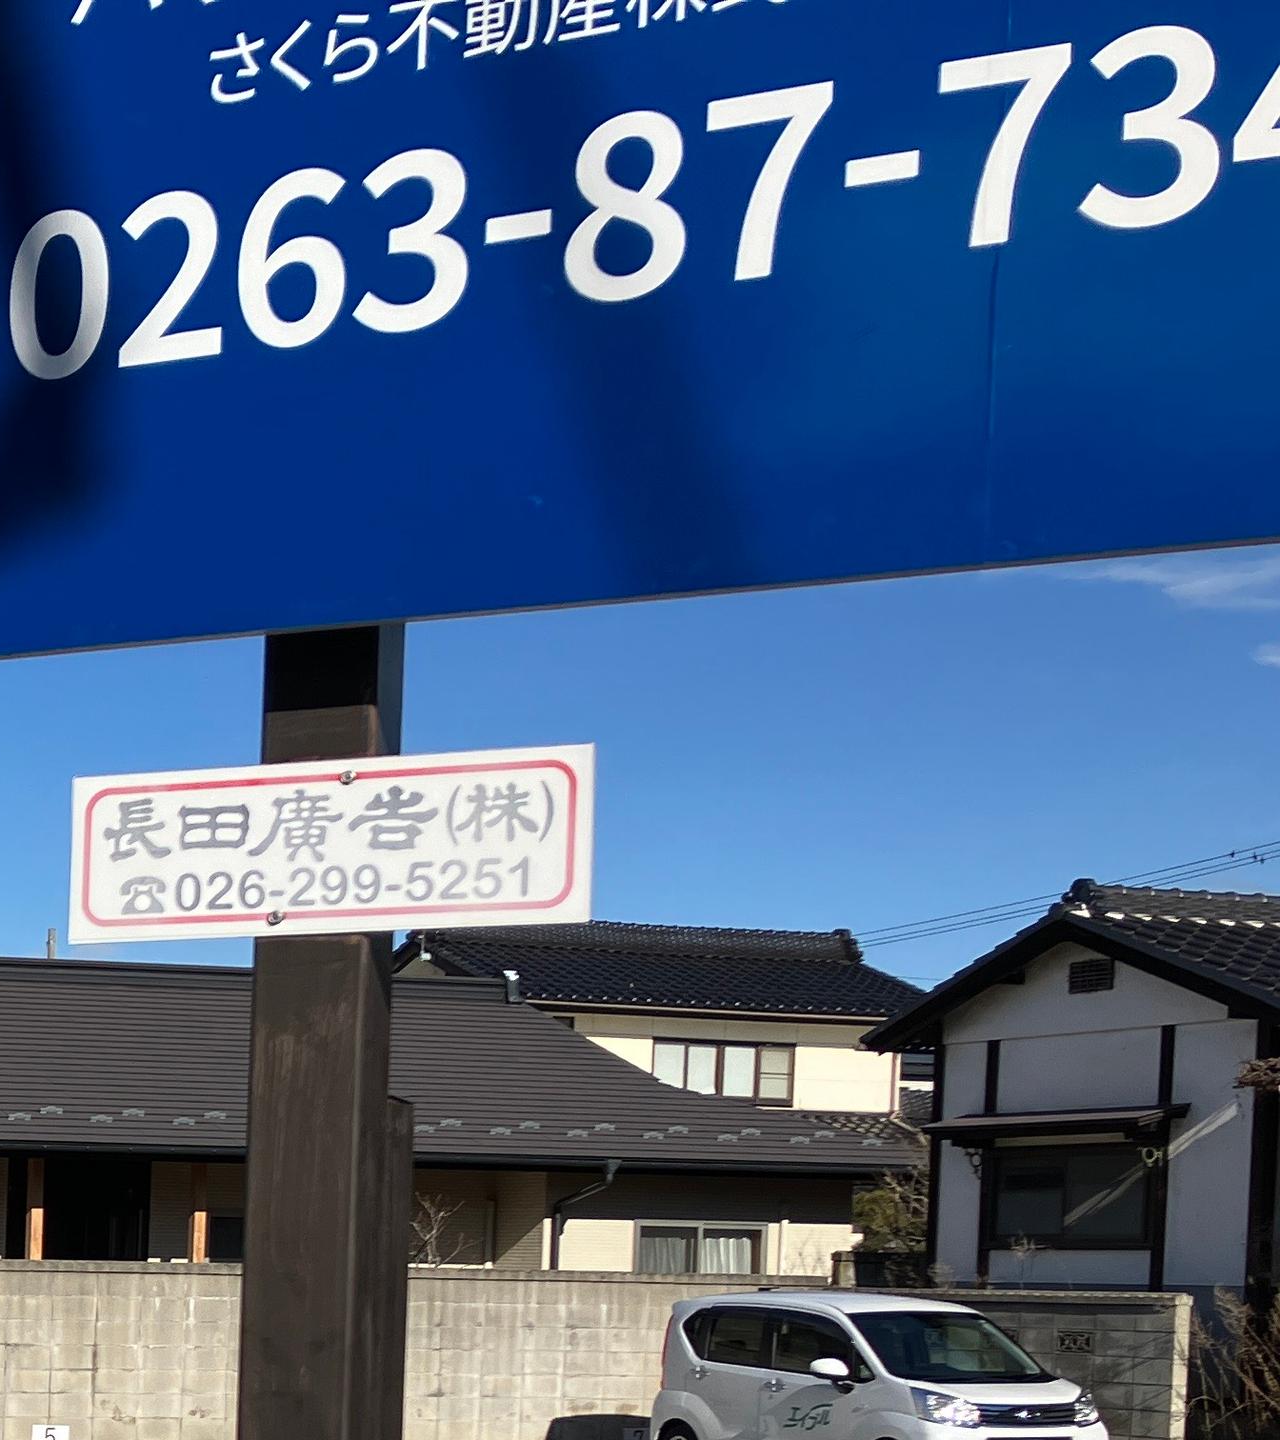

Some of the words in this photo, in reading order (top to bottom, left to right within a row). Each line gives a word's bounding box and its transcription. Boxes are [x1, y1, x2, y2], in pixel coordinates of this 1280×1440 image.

[209, 0, 787, 103] さくら不動産
[174, 856, 531, 912] 026-299-5251
